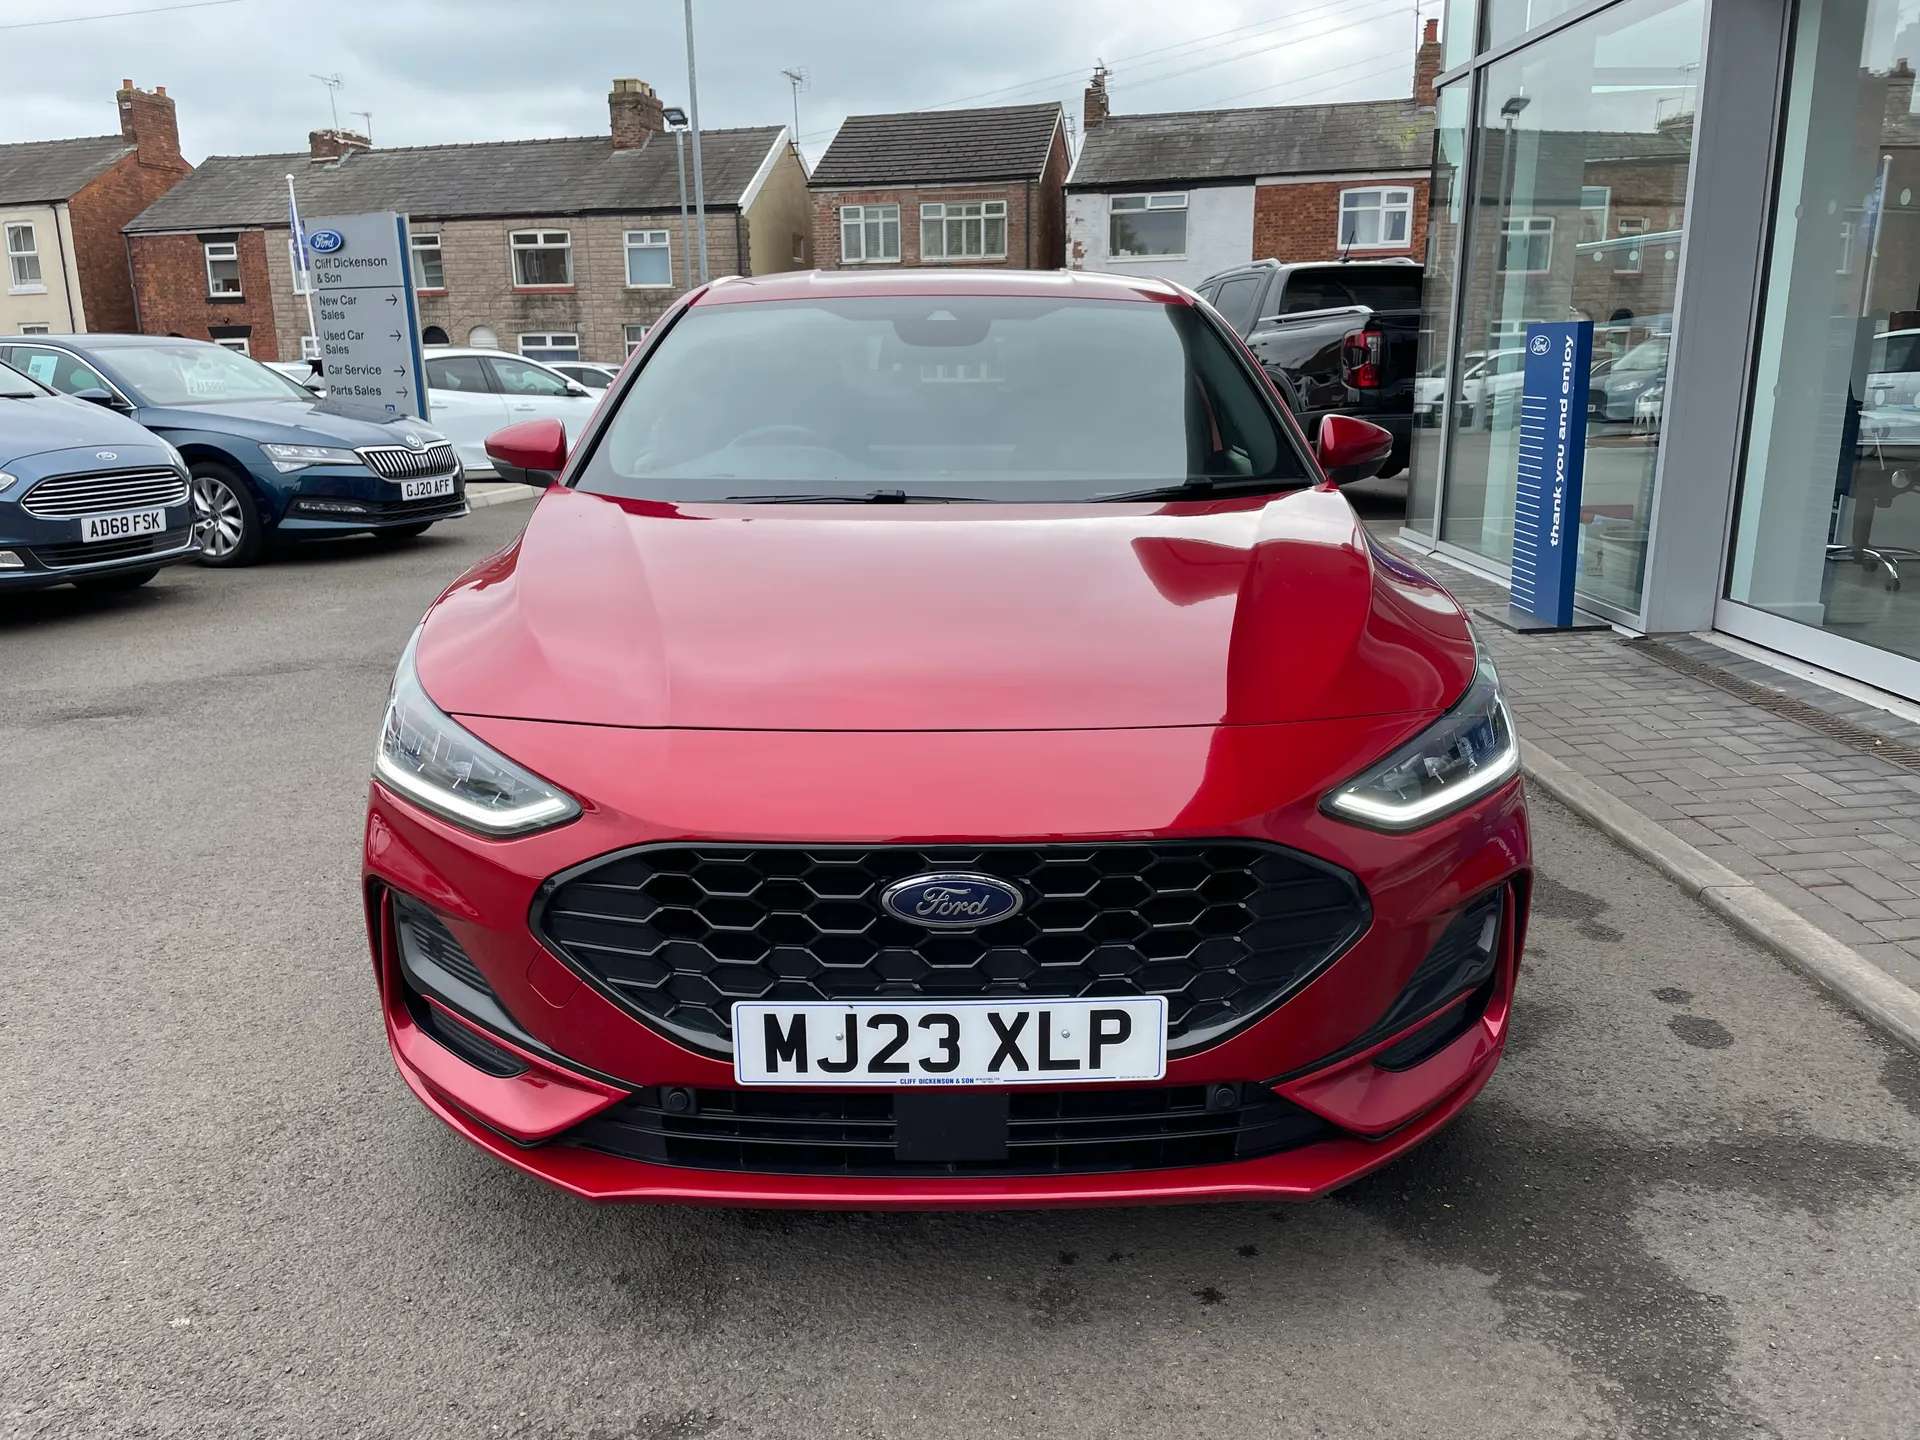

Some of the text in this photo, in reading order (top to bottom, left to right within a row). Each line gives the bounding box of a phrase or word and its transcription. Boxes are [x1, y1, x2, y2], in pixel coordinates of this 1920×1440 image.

[314, 233, 335, 249] Ford
[314, 256, 388, 270] Cliff Dickenson
[316, 273, 342, 284] & Son
[319, 294, 357, 306] New Car
[321, 309, 345, 320] Sales
[323, 330, 364, 341] Used Car
[325, 343, 350, 354] Sales
[328, 364, 382, 375] Car Service
[330, 385, 382, 396] Parts Sales
[1550, 334, 1574, 547] thank you and enjoy
[406, 478, 450, 497] GJ20 AFF
[90, 511, 160, 538] AD68 FSK
[915, 886, 991, 915] Ford
[763, 1008, 1132, 1074] MJ23 XLP
